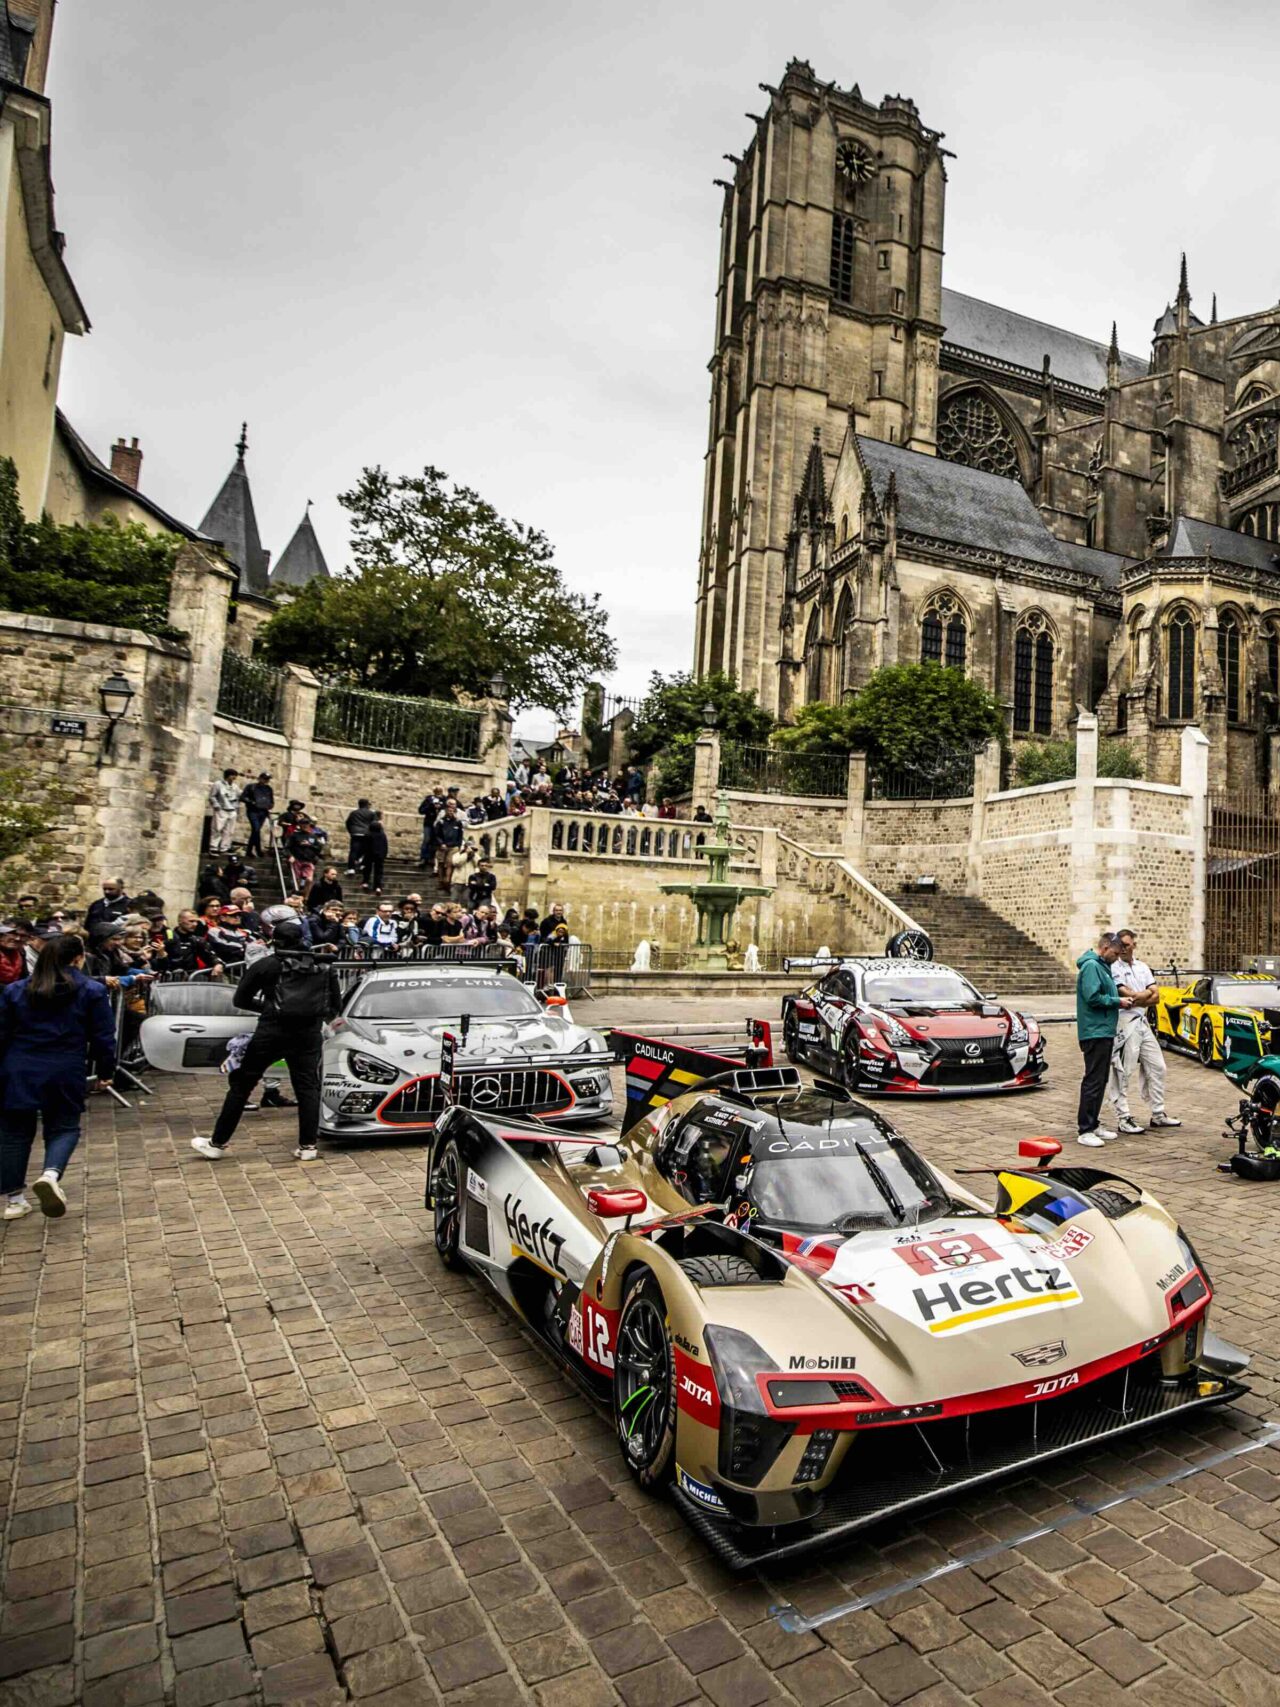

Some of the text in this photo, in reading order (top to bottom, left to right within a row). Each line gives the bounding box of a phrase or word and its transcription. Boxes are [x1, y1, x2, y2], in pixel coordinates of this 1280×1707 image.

[389, 980, 432, 988] IRON
[635, 1042, 674, 1064] CADILLAC
[324, 1089, 345, 1099] IWC
[504, 1192, 567, 1276] Hertz
[1049, 1233, 1091, 1260] CAR
[916, 1239, 988, 1272] 12
[1156, 1267, 1181, 1291] Mobil
[912, 1266, 1072, 1321] Hertz
[587, 1305, 615, 1370] 12
[789, 1356, 839, 1369] Mobil
[679, 1375, 712, 1406] JOTA
[1025, 1373, 1079, 1398] JOTA
[689, 1483, 724, 1506] MICHEL
